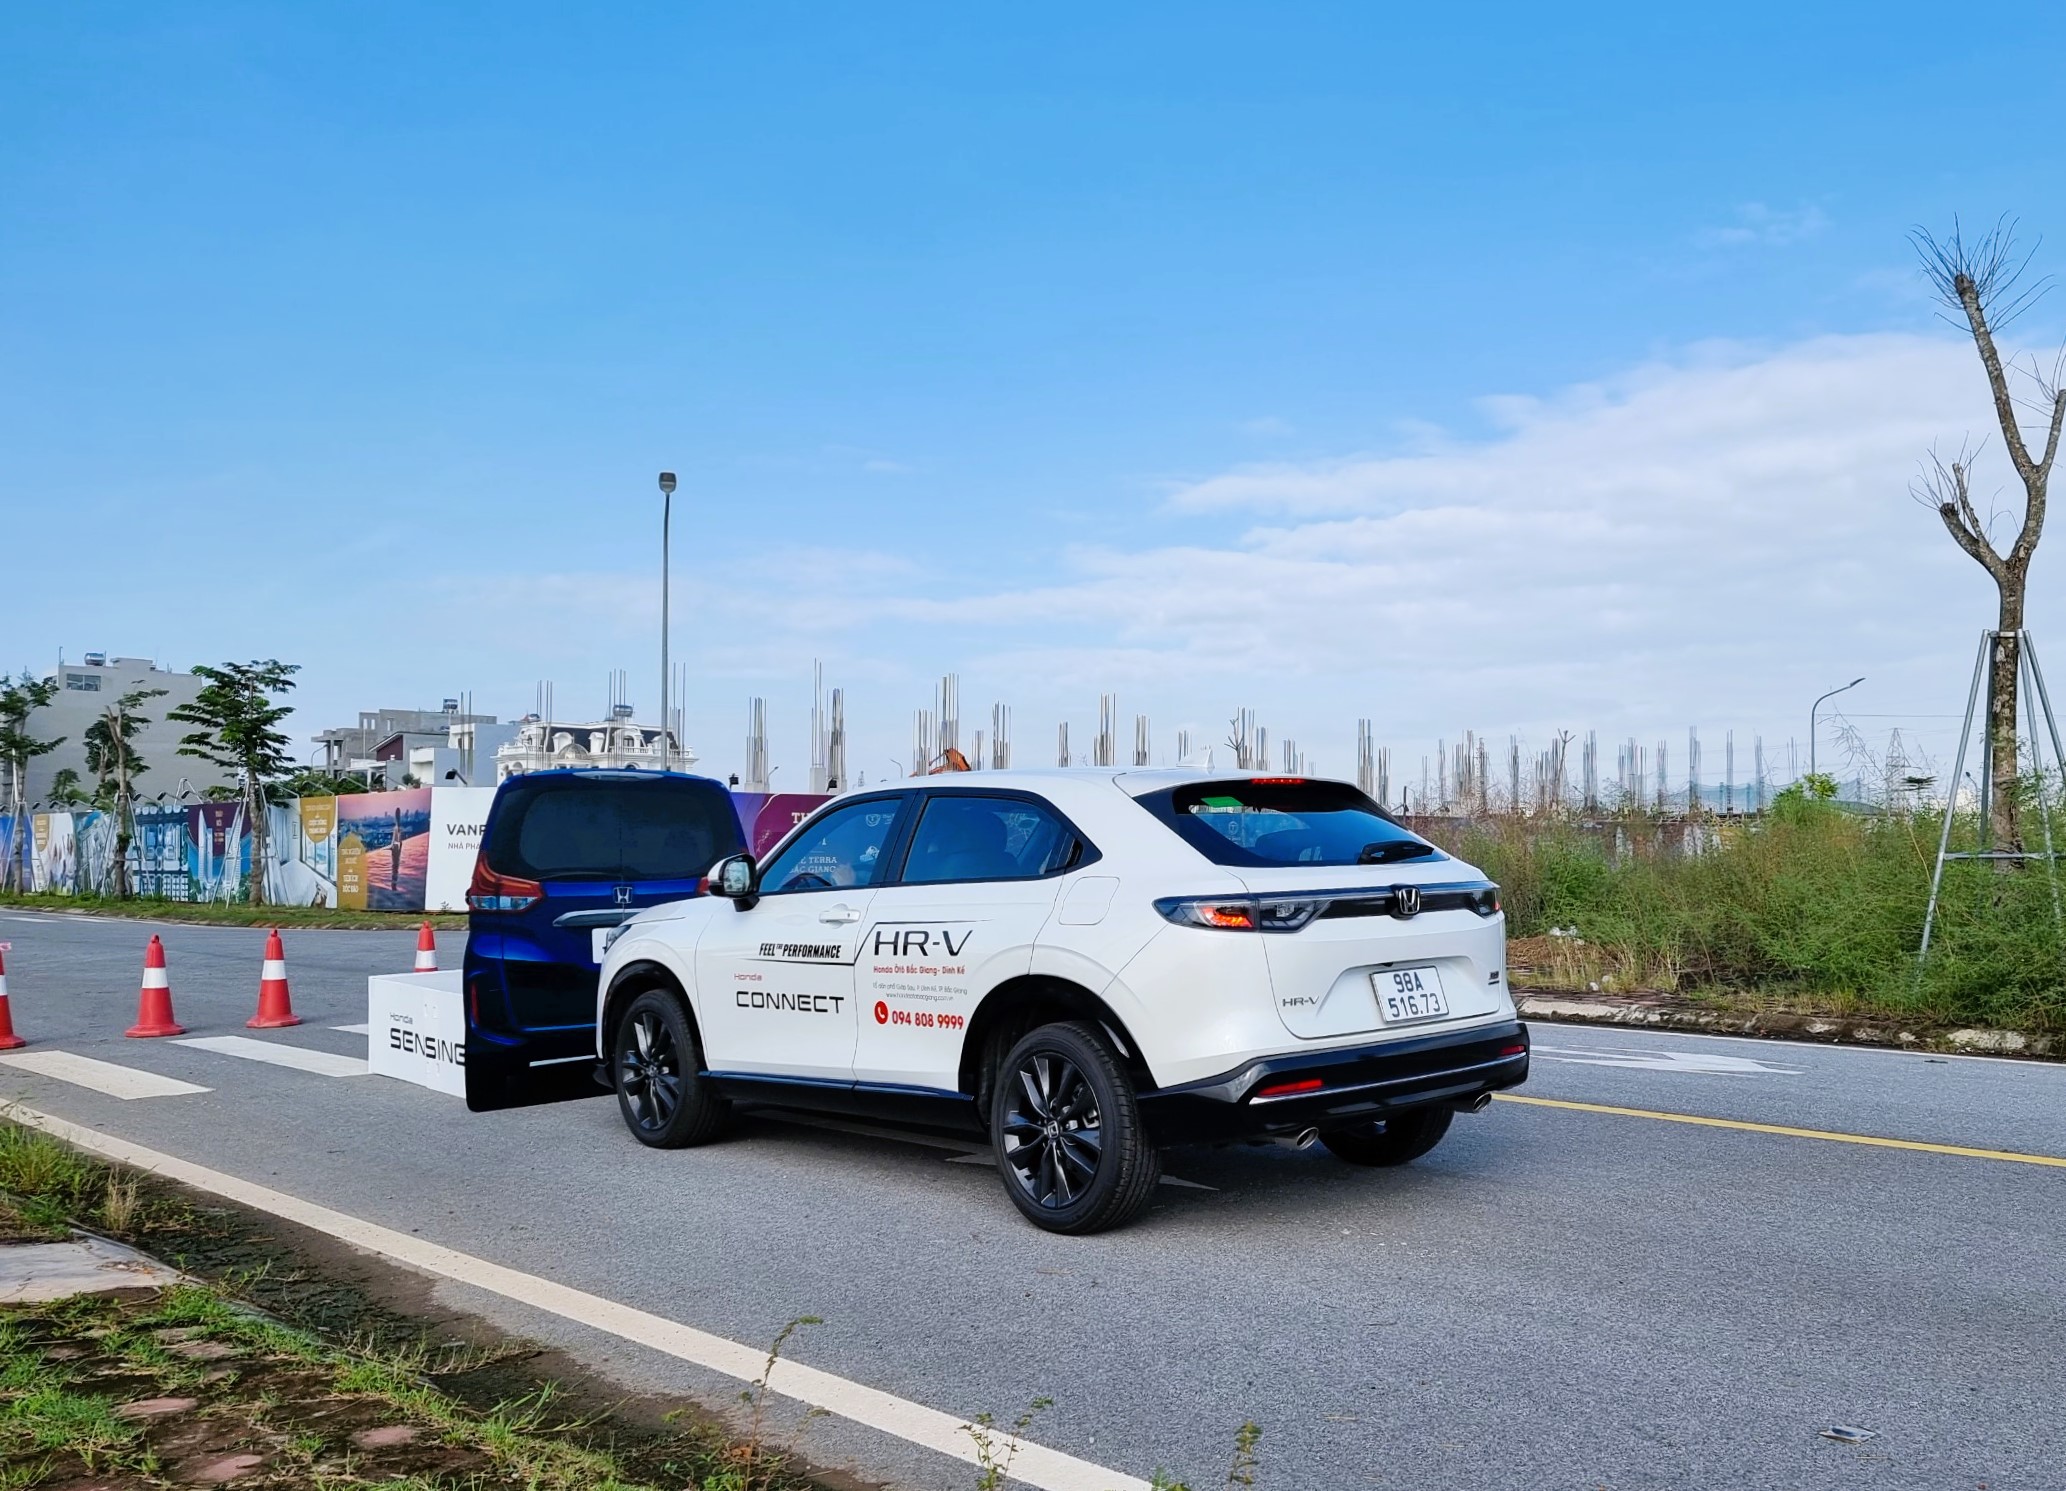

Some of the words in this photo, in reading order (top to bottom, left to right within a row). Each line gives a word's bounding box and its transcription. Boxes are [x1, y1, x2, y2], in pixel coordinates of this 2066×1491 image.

[808, 856, 838, 864] TERRA
[758, 943, 776, 957] FEEL
[782, 944, 842, 959] PERFORMANCE
[873, 930, 974, 957] HR-V
[734, 972, 762, 982] Honda
[873, 965, 893, 974] Honda
[906, 963, 918, 974] Bắc
[956, 964, 966, 975] Kế
[1393, 971, 1425, 994] 98A
[736, 991, 845, 1014] CONNECT
[1282, 996, 1320, 1007] HR-V
[1387, 993, 1441, 1018] 516.73
[389, 1011, 414, 1025] Honda
[892, 1010, 912, 1026] 094
[914, 1012, 934, 1028] 808
[937, 1013, 964, 1030] 9999
[389, 1027, 466, 1067] SENSING
